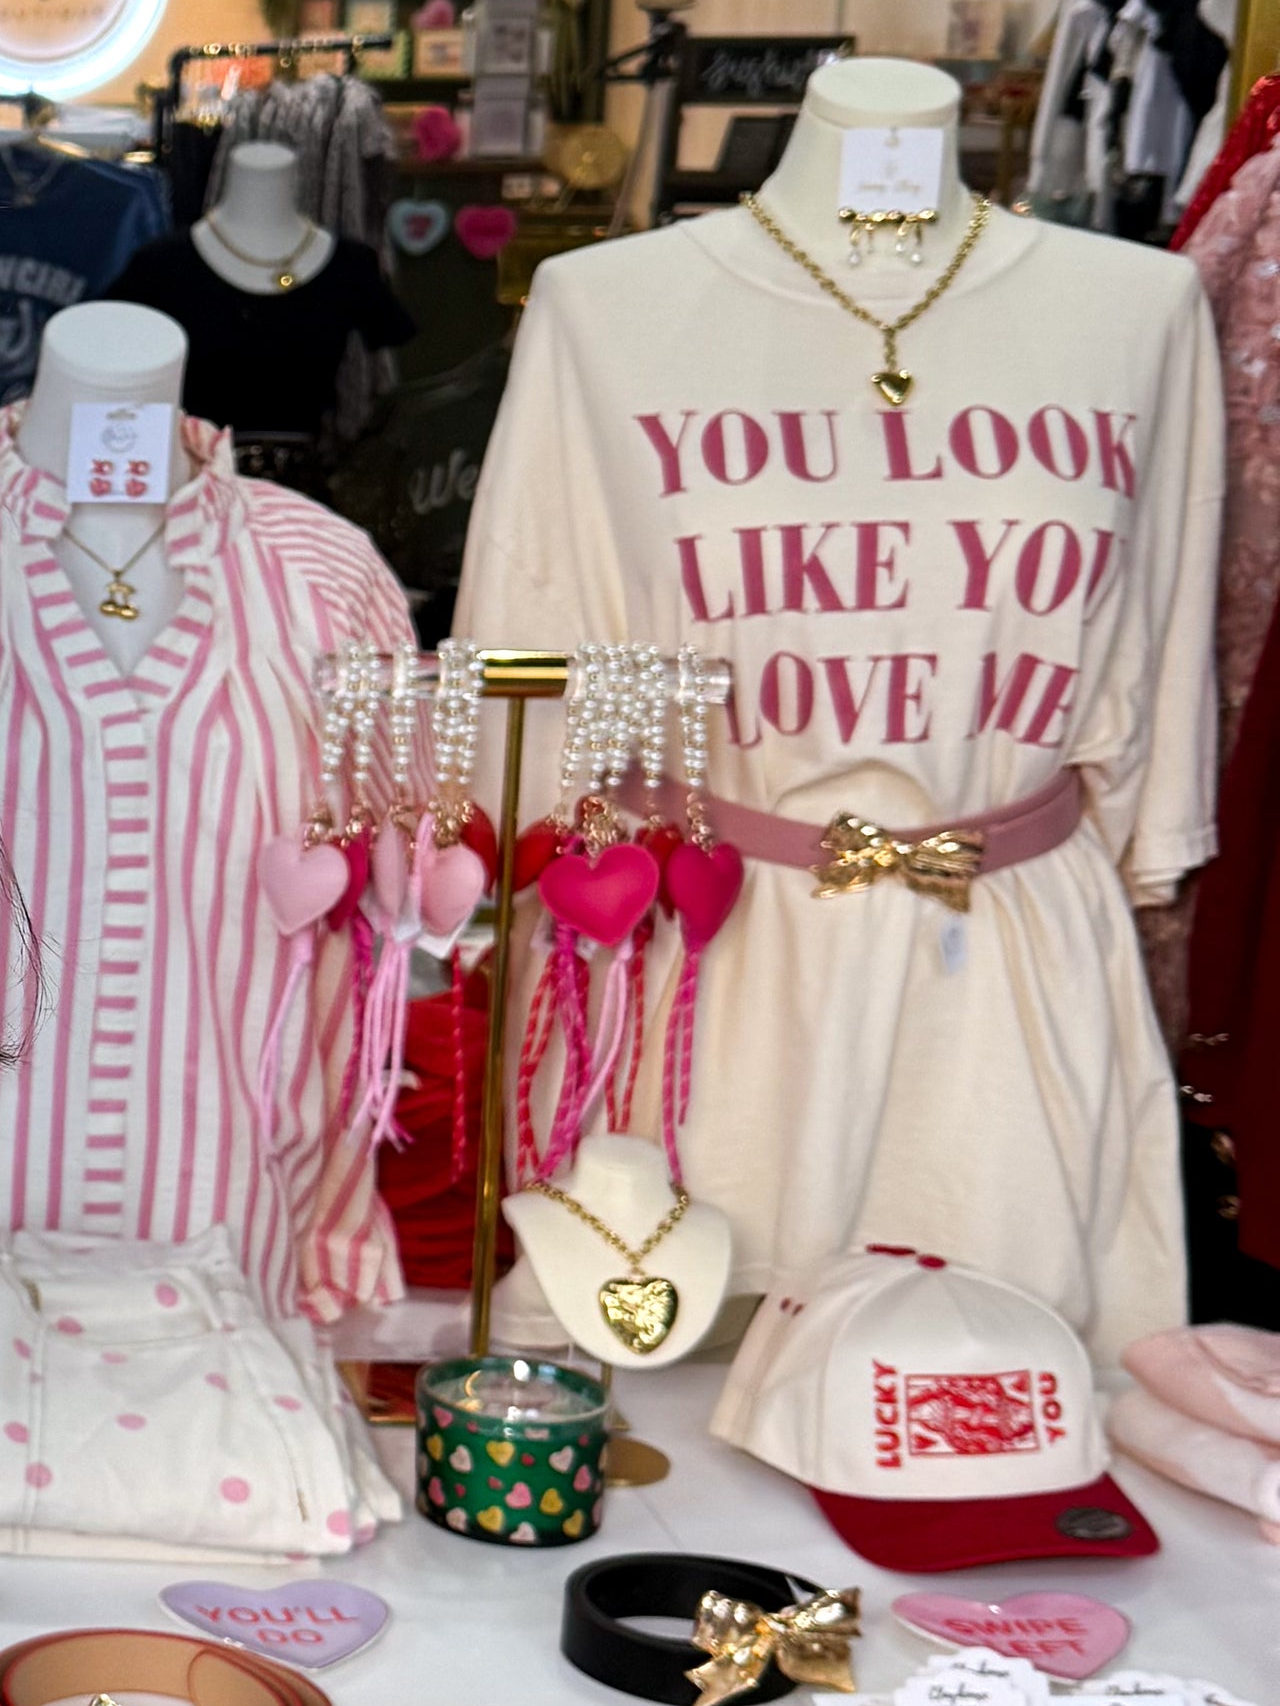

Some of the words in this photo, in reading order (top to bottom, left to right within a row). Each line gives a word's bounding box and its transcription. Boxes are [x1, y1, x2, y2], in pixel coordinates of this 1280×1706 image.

[634, 409, 840, 497] YOU
[876, 404, 1138, 500] LOOK
[675, 521, 911, 624] LIKE
[724, 650, 939, 749] LOVE
[872, 1358, 902, 1469] LUCKY
[1038, 1371, 1067, 1444] YOU
[195, 1605, 357, 1625] YOU'LL
[257, 1629, 324, 1645] DO
[944, 1618, 1087, 1635] SWIPE
